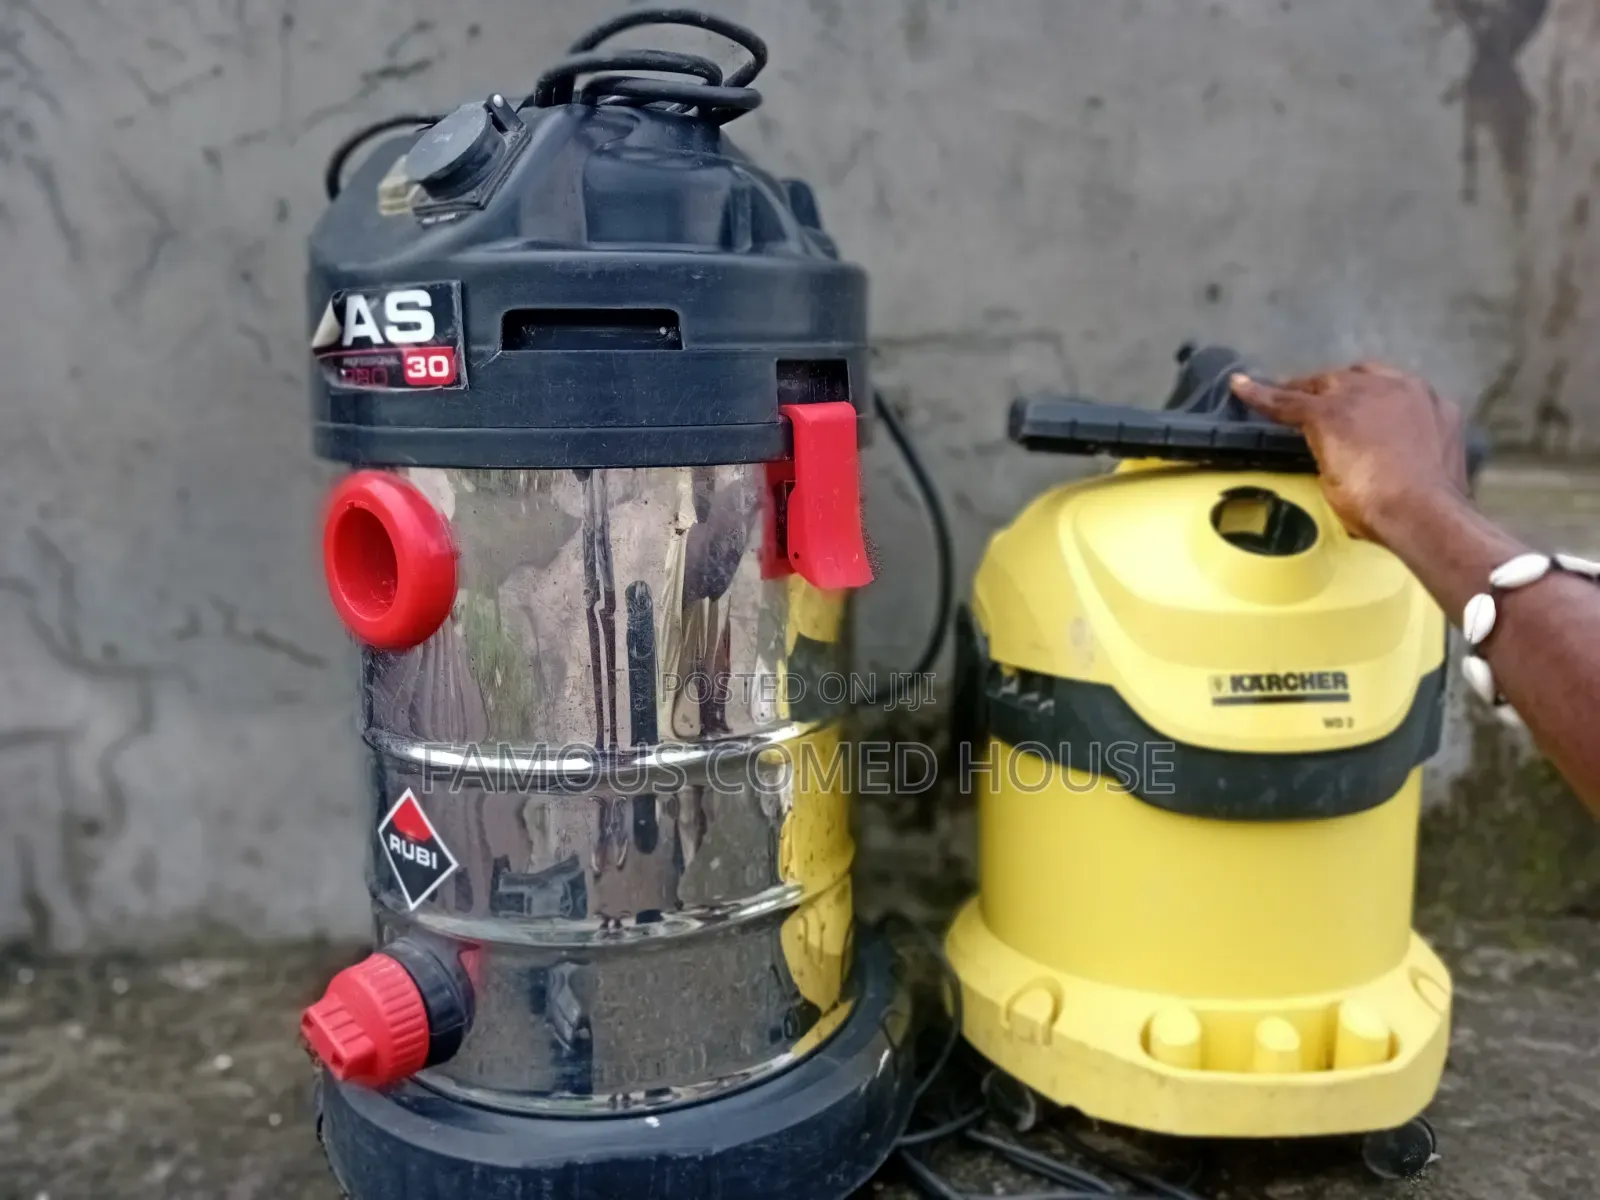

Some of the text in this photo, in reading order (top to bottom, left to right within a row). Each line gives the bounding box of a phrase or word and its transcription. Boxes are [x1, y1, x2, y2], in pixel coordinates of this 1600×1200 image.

[342, 289, 435, 347] AS
[407, 355, 449, 378] 30
[389, 832, 437, 870] RUBI
